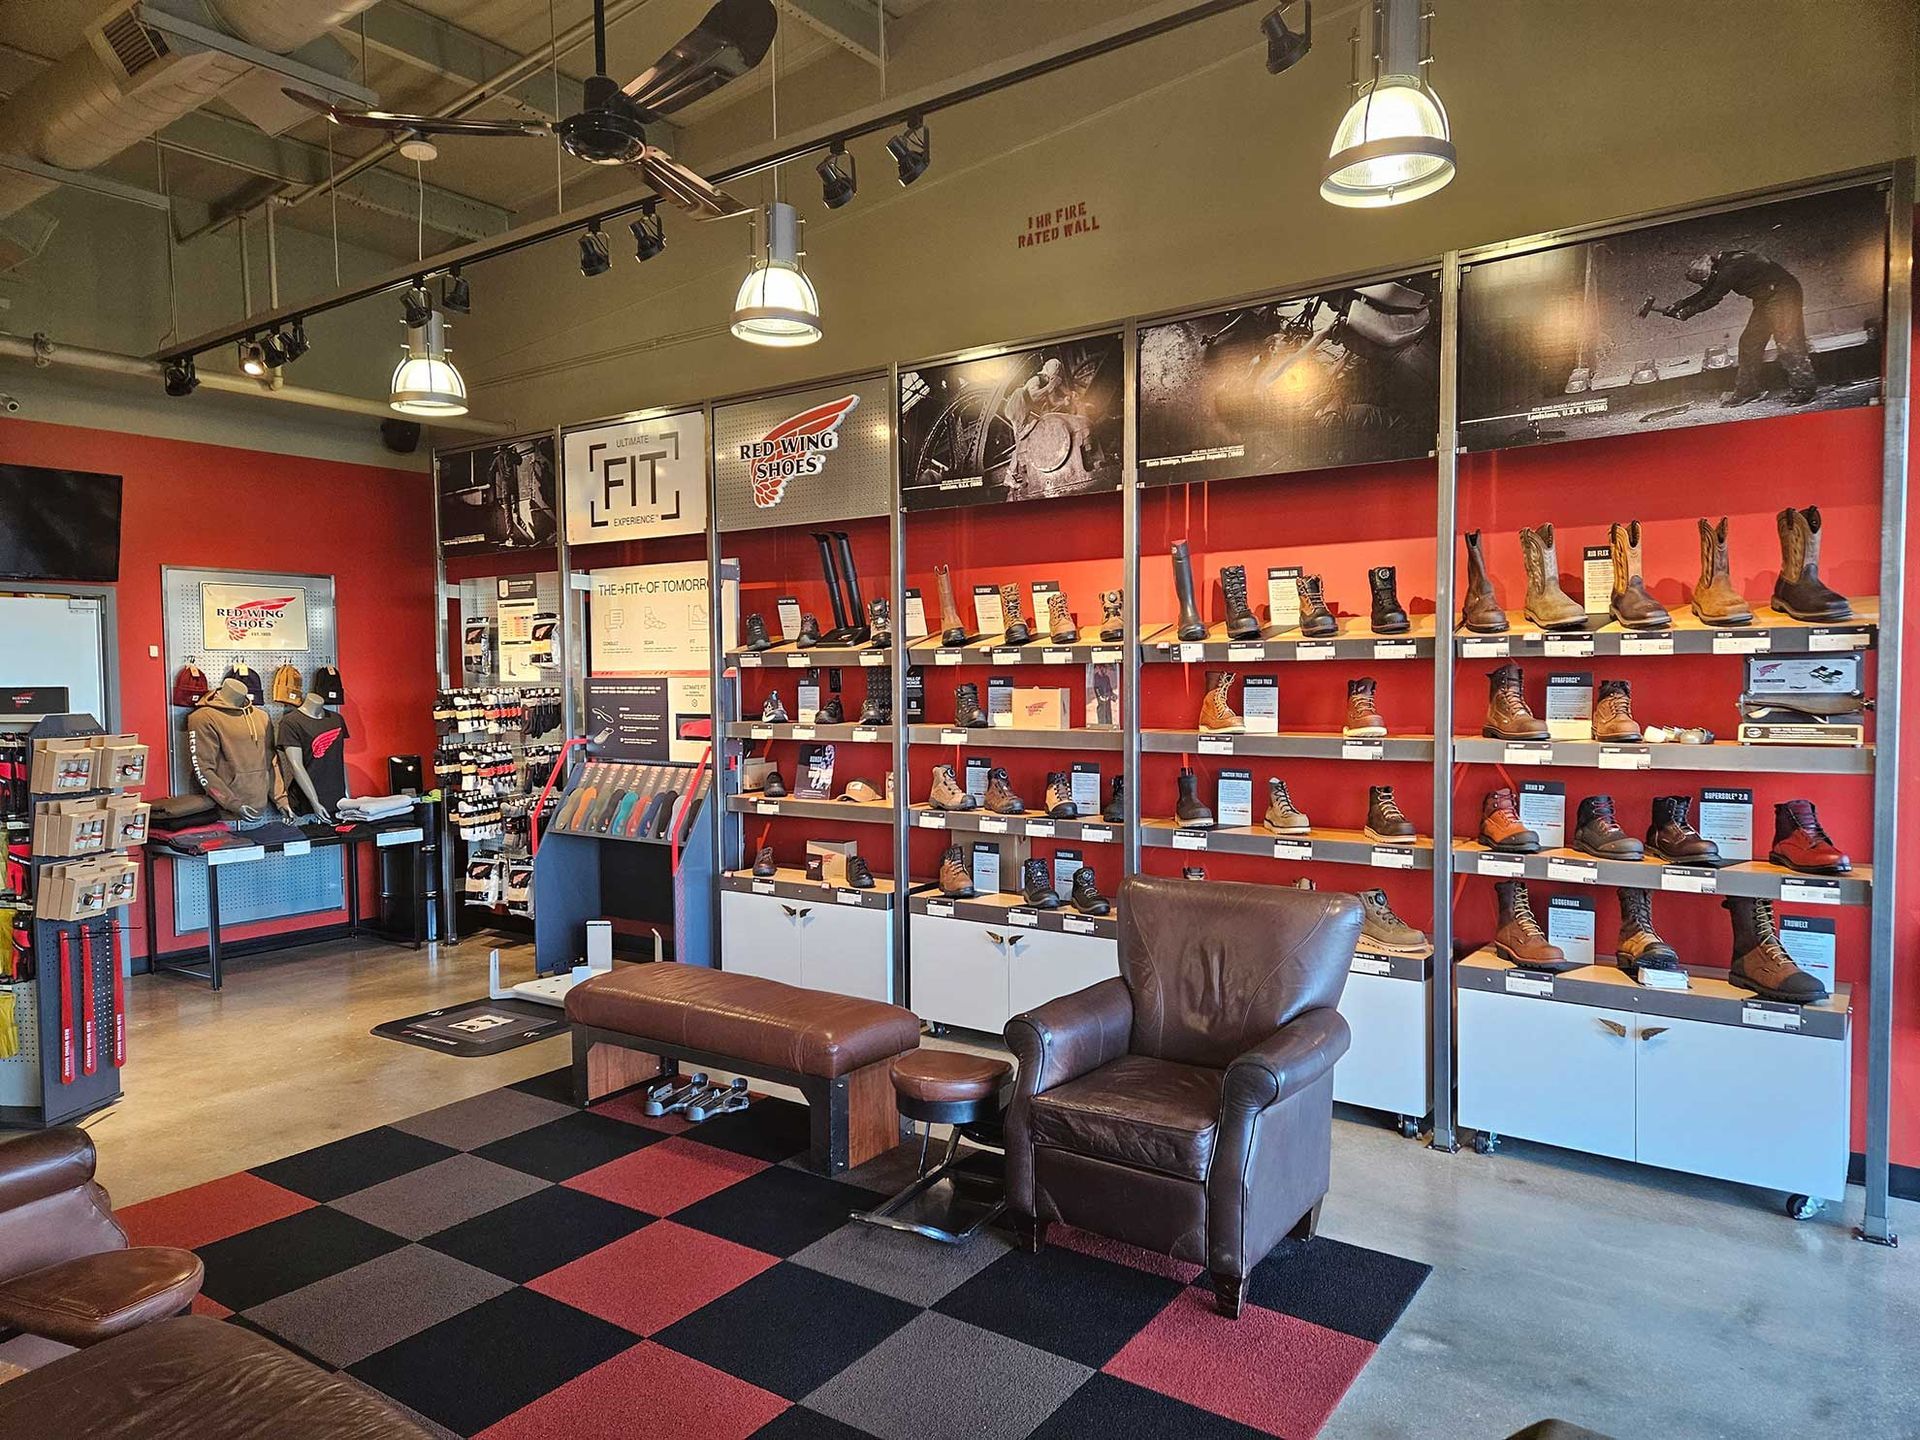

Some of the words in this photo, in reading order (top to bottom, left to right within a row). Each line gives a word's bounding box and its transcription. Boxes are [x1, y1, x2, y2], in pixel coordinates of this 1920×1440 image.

[1036, 213, 1052, 229] HR
[1056, 202, 1086, 223] FIRE
[1018, 227, 1060, 248] RATED
[1064, 216, 1100, 237] WALL
[616, 435, 649, 448] ULTIMATE
[740, 441, 775, 460] RED
[781, 432, 833, 454] WING
[604, 451, 667, 509] FIT
[757, 457, 817, 479] SHOES
[598, 584, 617, 596] THE
[625, 582, 640, 595] FIT
[646, 581, 660, 593] OF
[662, 578, 708, 592] TOMORR
[217, 608, 242, 617] RED
[247, 609, 284, 619] WING
[229, 620, 274, 629] SHOES
[191, 755, 208, 787] WING
